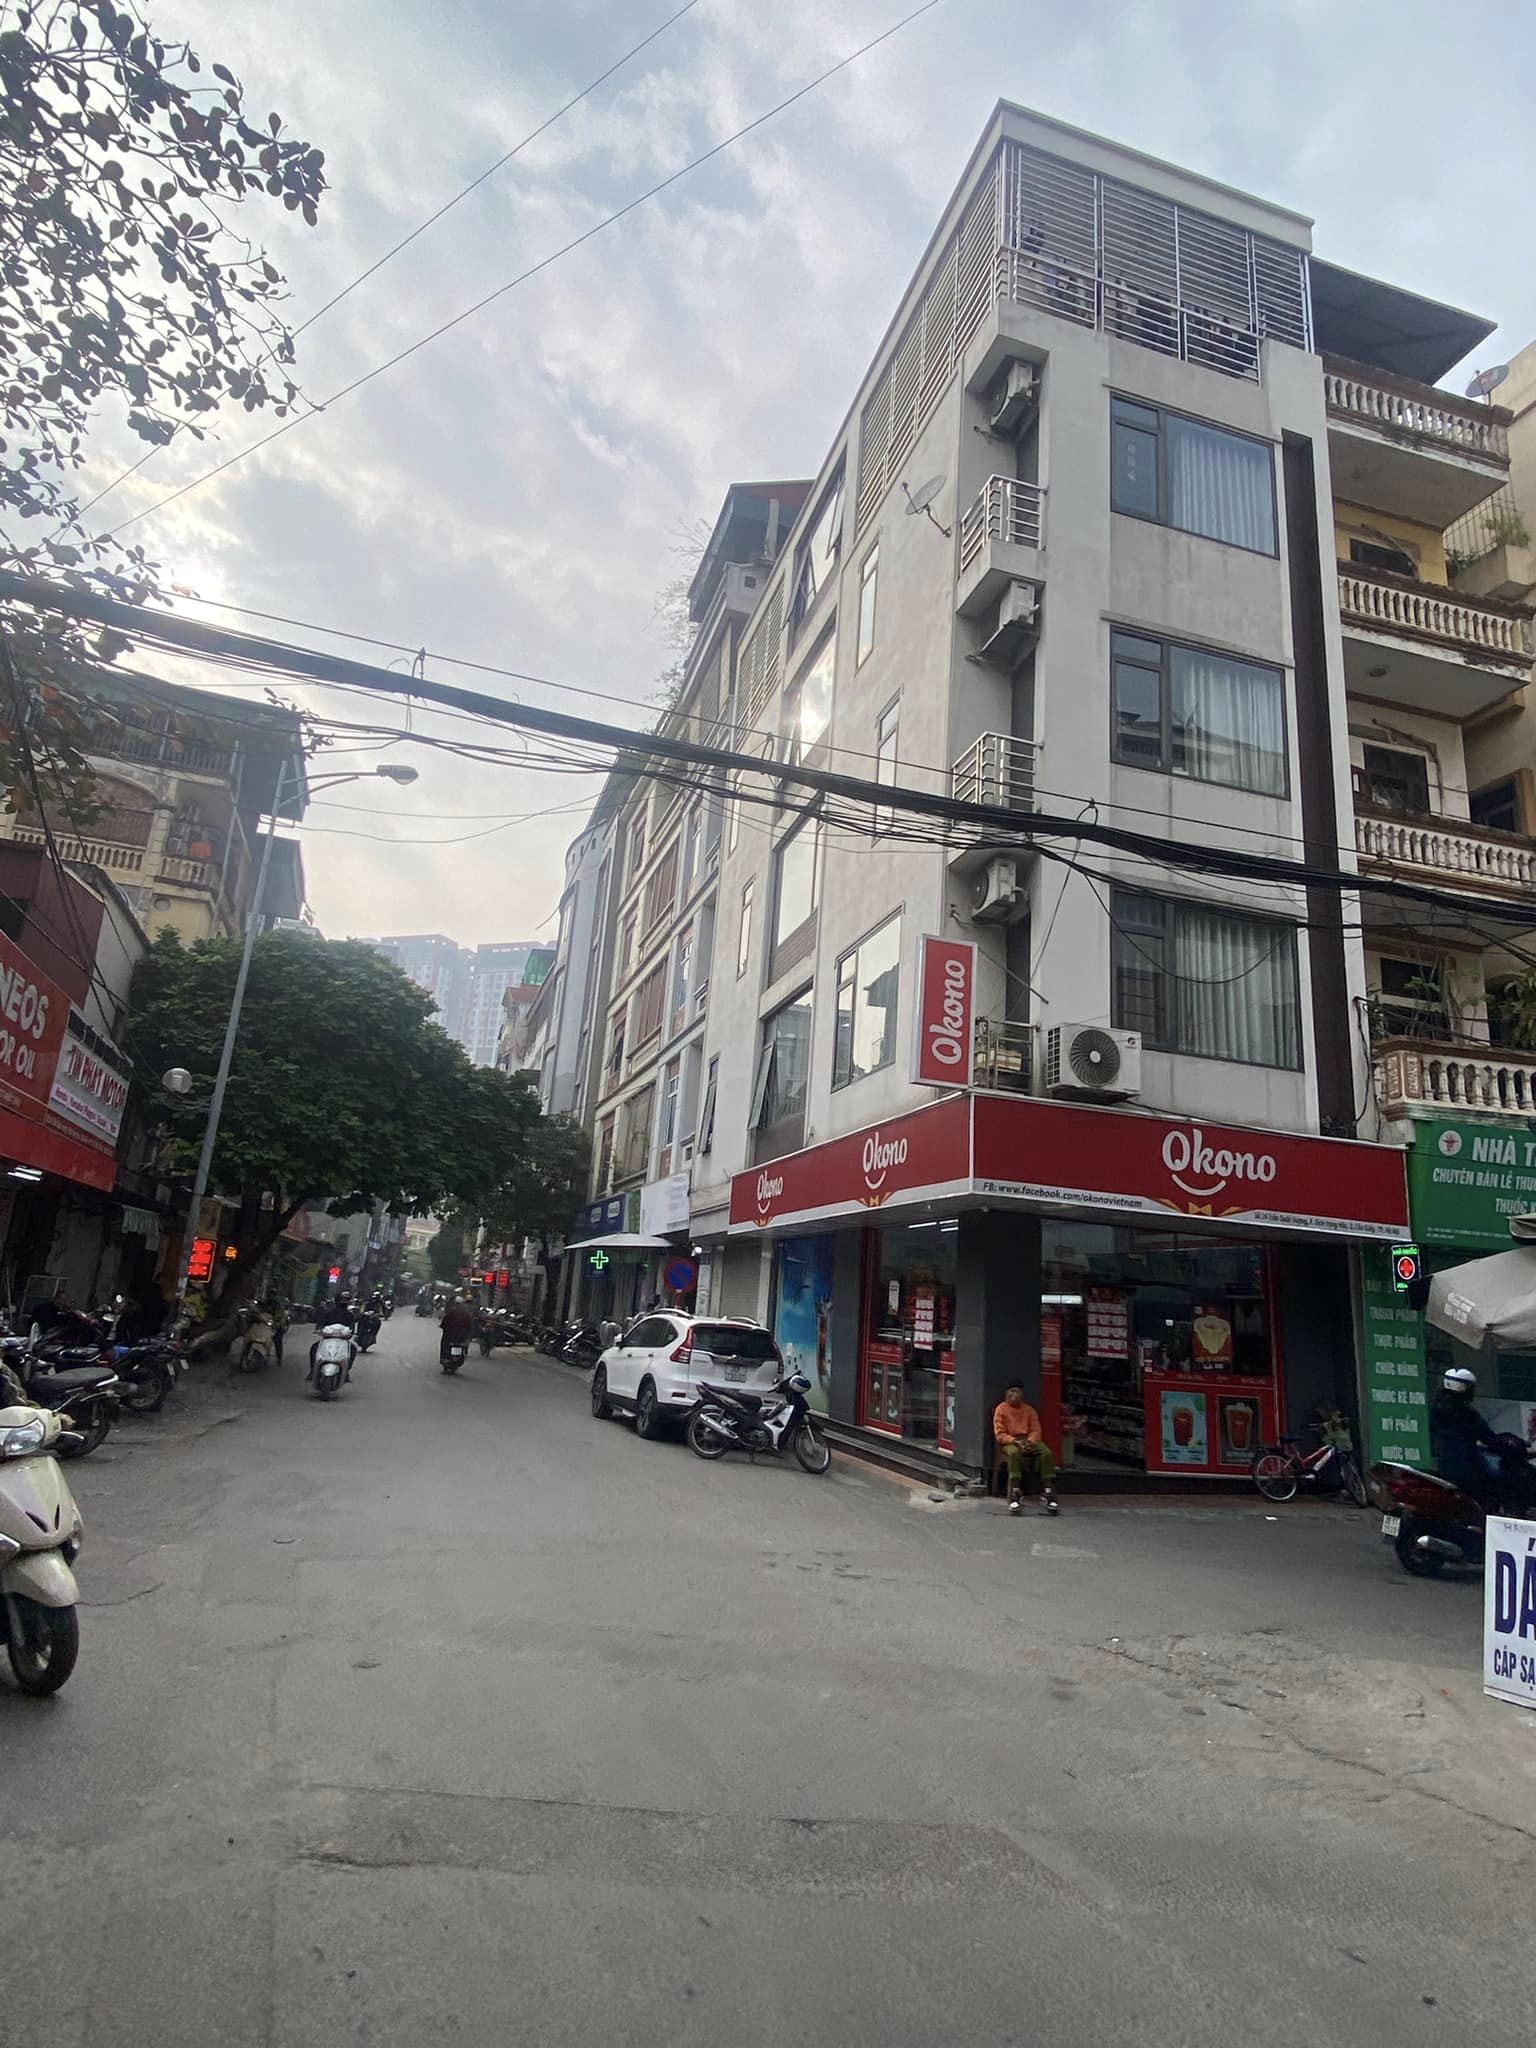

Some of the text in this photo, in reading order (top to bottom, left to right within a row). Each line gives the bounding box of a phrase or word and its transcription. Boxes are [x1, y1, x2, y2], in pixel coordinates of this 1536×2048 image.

[929, 959, 966, 1065] Okono
[16, 1044, 36, 1080] OIL
[862, 1131, 908, 1173] Okono
[1162, 1128, 1276, 1182] Okono
[1472, 1135, 1516, 1166] NHÀ
[757, 1170, 783, 1200] Okono
[983, 1182, 998, 1191] FB:
[1433, 1168, 1474, 1187] CHUYÊN
[1475, 1170, 1499, 1188] BÁN
[1495, 1194, 1529, 1214] THUỐC
